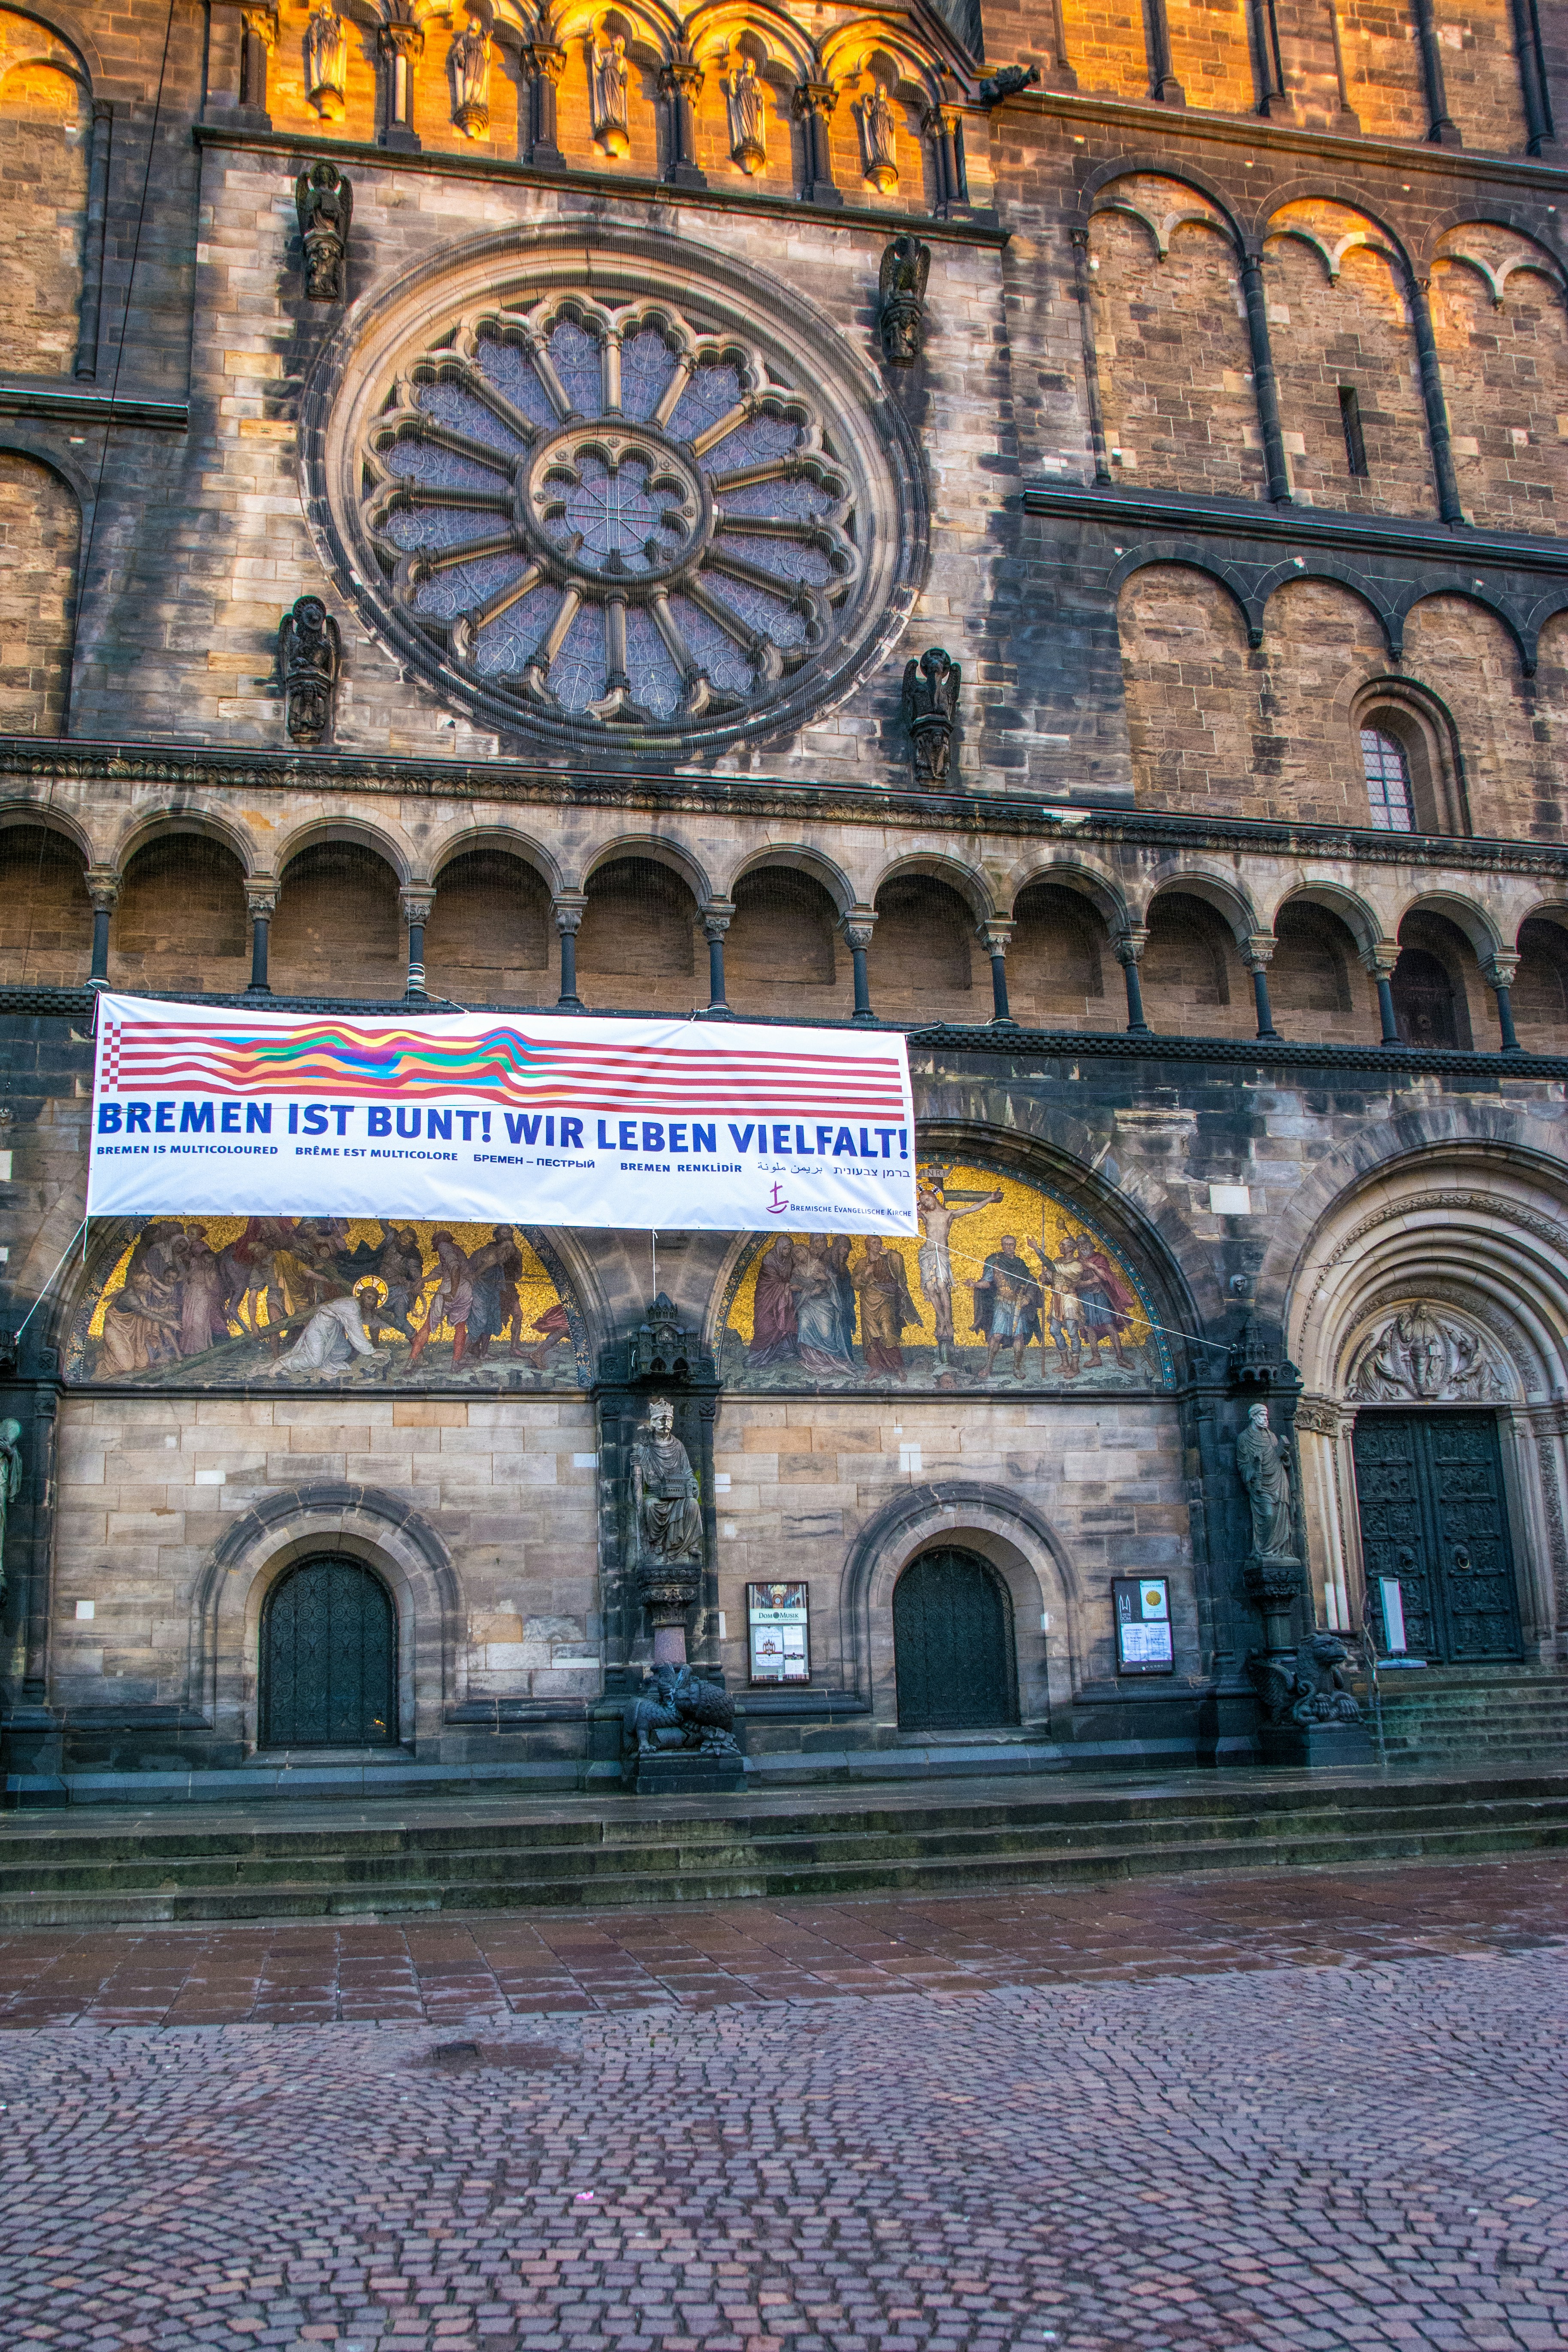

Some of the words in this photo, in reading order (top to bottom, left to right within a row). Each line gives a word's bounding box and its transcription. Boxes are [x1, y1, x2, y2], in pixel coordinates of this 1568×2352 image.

[97, 1101, 272, 1134] BREMEN
[288, 1103, 355, 1135] IST
[367, 1106, 491, 1142] BUNT!
[504, 1113, 583, 1148] WIR
[598, 1119, 716, 1152] LEBEN
[728, 1124, 908, 1159] VIELFALT!
[96, 1146, 149, 1155] BREMEN
[153, 1145, 166, 1153] IS
[170, 1145, 278, 1154] MULTICOLOURED
[296, 1146, 339, 1156] BRÊME
[344, 1148, 366, 1156] EST
[371, 1149, 457, 1160] MULTICOLORE
[474, 1154, 523, 1164] БРЕМЕН
[537, 1158, 595, 1168] ПЕСТРЫЙ
[621, 1162, 670, 1172] BREMEN
[758, 1162, 786, 1173] ملونة
[791, 1165, 822, 1174] بريمن
[834, 1167, 878, 1176] צבעונית
[883, 1170, 910, 1178] ברמן
[834, 1205, 885, 1215] EVANGELISCHE
